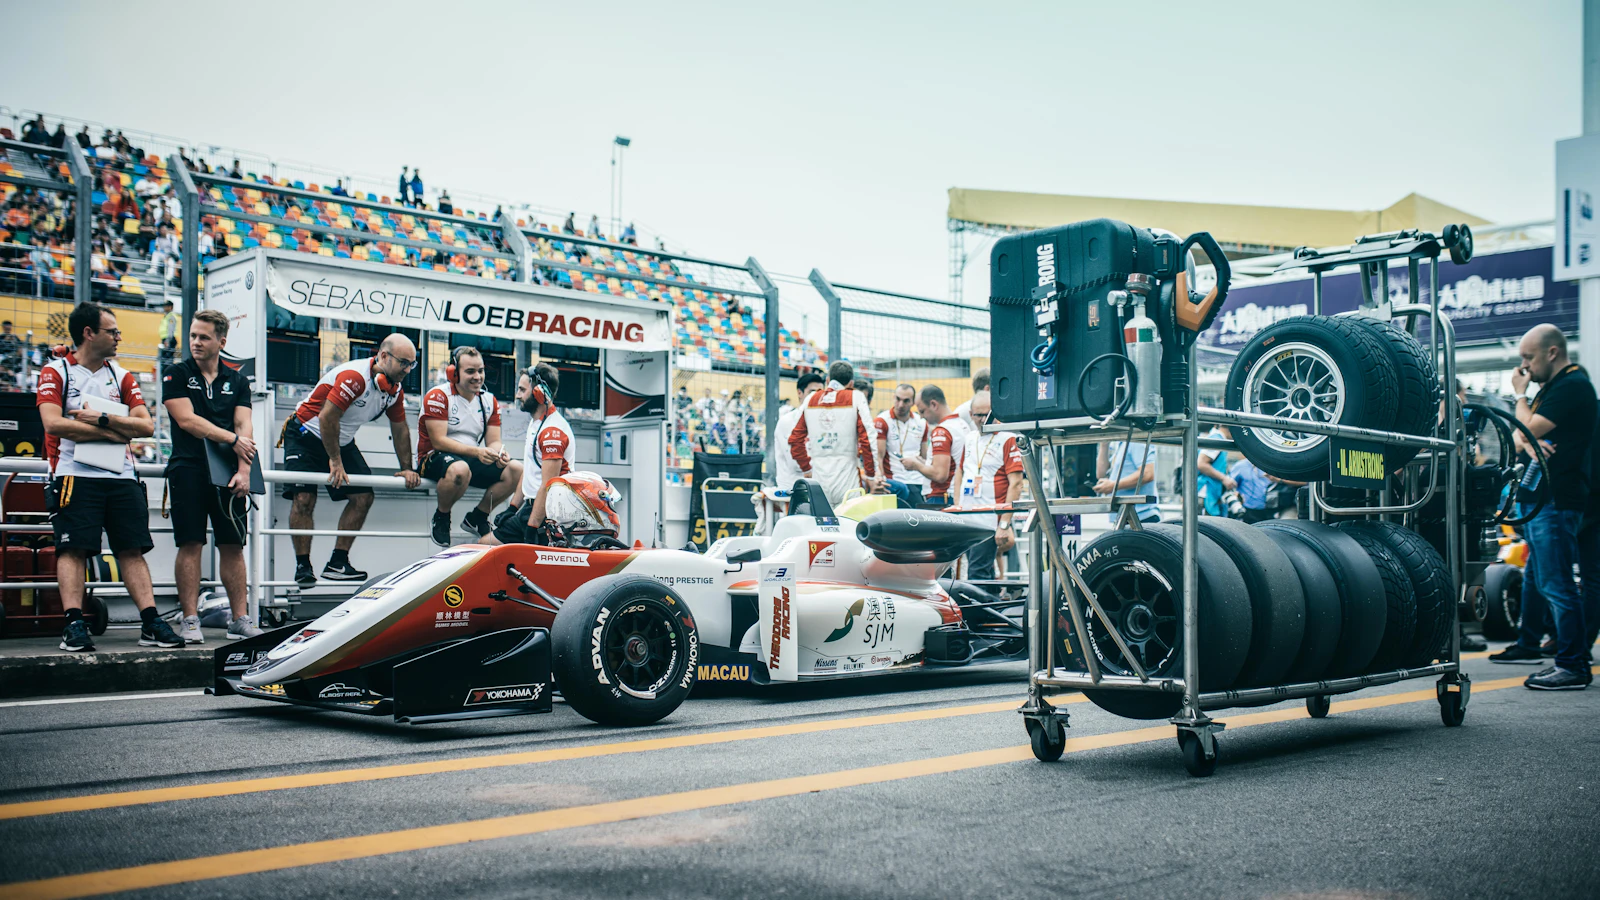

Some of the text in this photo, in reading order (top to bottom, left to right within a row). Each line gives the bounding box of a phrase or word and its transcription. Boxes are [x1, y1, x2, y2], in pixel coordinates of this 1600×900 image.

[1493, 299, 1544, 316] GROUP
[1348, 449, 1385, 481] ARMSTRONG
[540, 554, 585, 563] RAVENOL
[676, 576, 714, 585] PRESTIGE
[781, 585, 791, 641] RACING
[865, 595, 897, 621] 澳博
[591, 606, 612, 685] ADVAN
[769, 595, 782, 671] THEODORE
[863, 622, 894, 649] SJM
[1086, 621, 1104, 661] RACING
[663, 649, 677, 681] RACING
[679, 628, 698, 689] YOKOHAMA
[814, 658, 839, 667] Nissens
[697, 664, 749, 681] MACAU
[485, 687, 532, 700] YOKOHAMA
